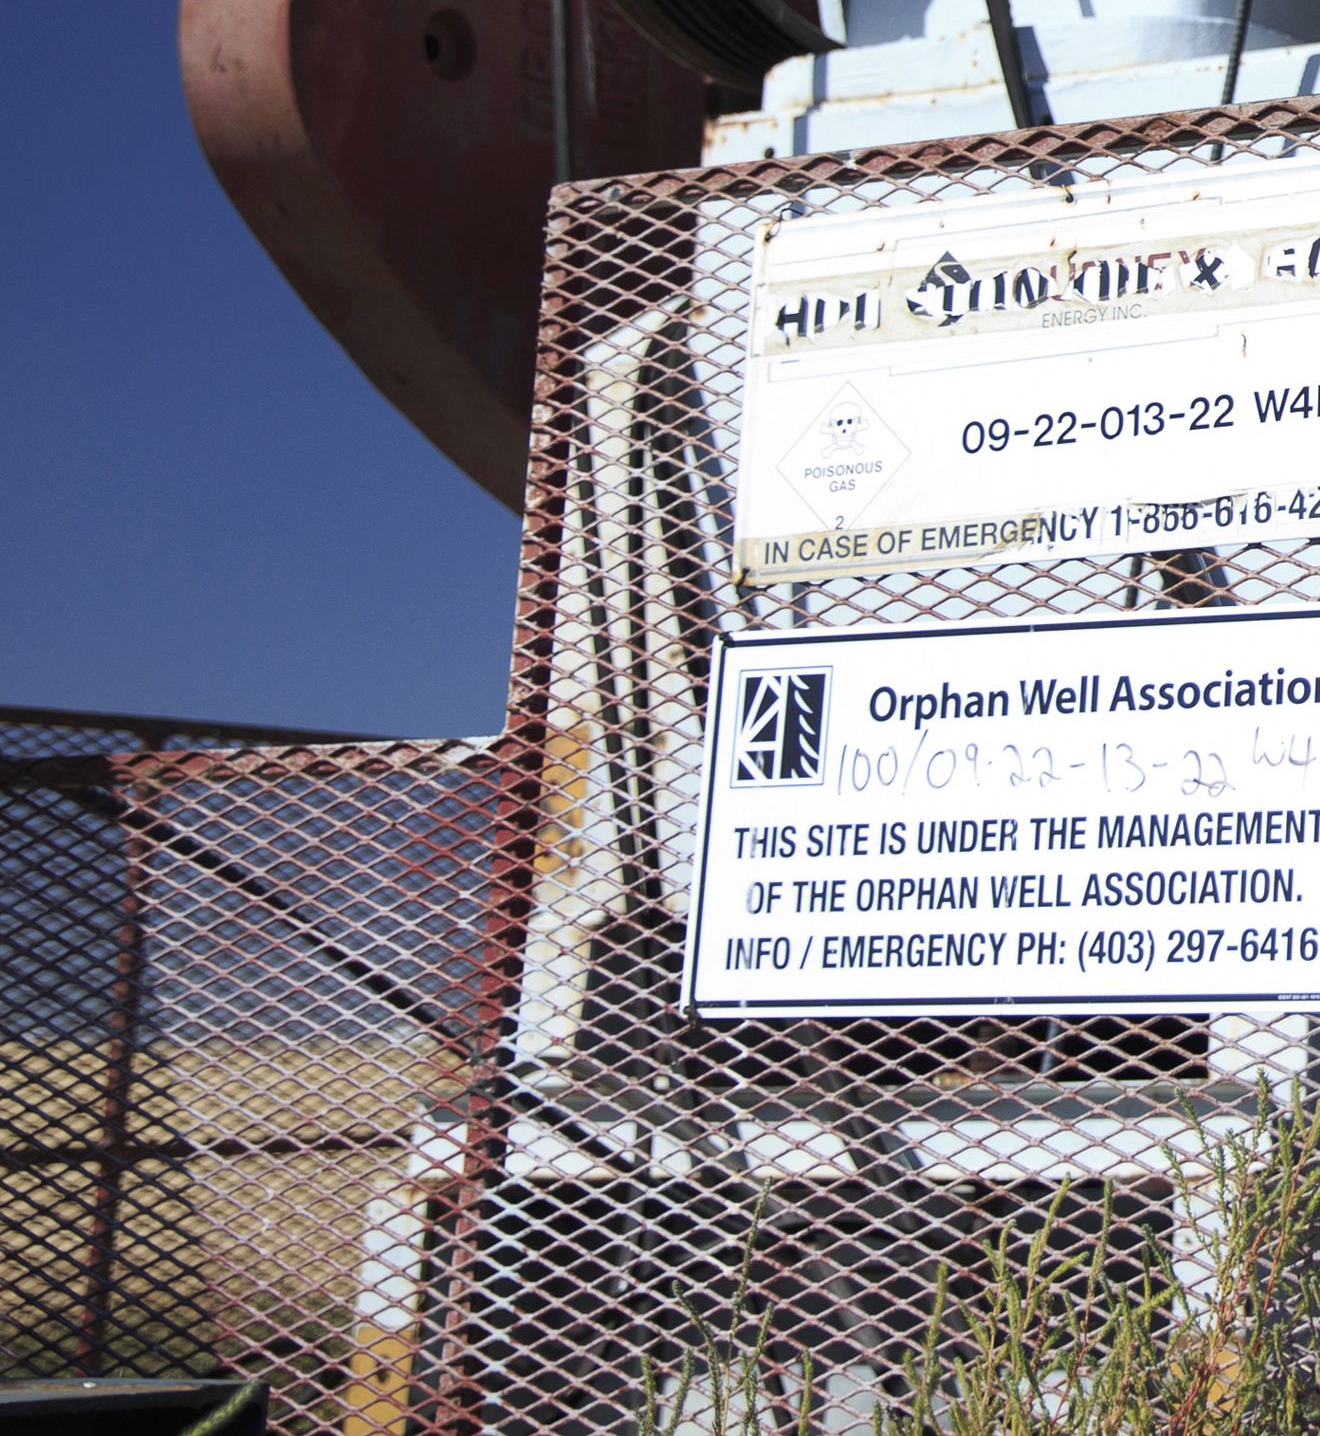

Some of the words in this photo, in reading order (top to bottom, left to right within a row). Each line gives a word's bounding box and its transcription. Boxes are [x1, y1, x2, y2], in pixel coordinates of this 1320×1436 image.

[1042, 308, 1107, 328] ENERGY
[1112, 303, 1147, 320] INC.
[963, 395, 1233, 454] 09-22-013-22
[805, 461, 882, 479] POISONOUS
[829, 479, 856, 492] GAS
[765, 542, 788, 564] IN
[799, 533, 867, 561] CASE
[878, 530, 912, 554] OF
[922, 507, 1098, 550] EMERGENCY
[834, 516, 844, 531] 2
[870, 682, 1008, 730] Orphan
[1020, 675, 1099, 715] Well
[735, 826, 796, 858] THIS
[807, 824, 869, 857] SITE
[880, 822, 906, 854] IS
[918, 819, 1017, 854] UNDER
[1030, 817, 1086, 850] THE
[746, 882, 782, 914] OF
[793, 880, 846, 912] THE
[857, 877, 978, 911] ORPHAN
[991, 875, 1070, 908] WELL
[1082, 869, 1302, 906] ASSOCIATION.
[726, 937, 790, 970] INFO
[800, 936, 813, 969] /
[822, 933, 1006, 968] EMERGENCY
[1018, 932, 1065, 965] PH:
[1079, 930, 1154, 972] (403)
[1167, 928, 1318, 963] 297-6416
